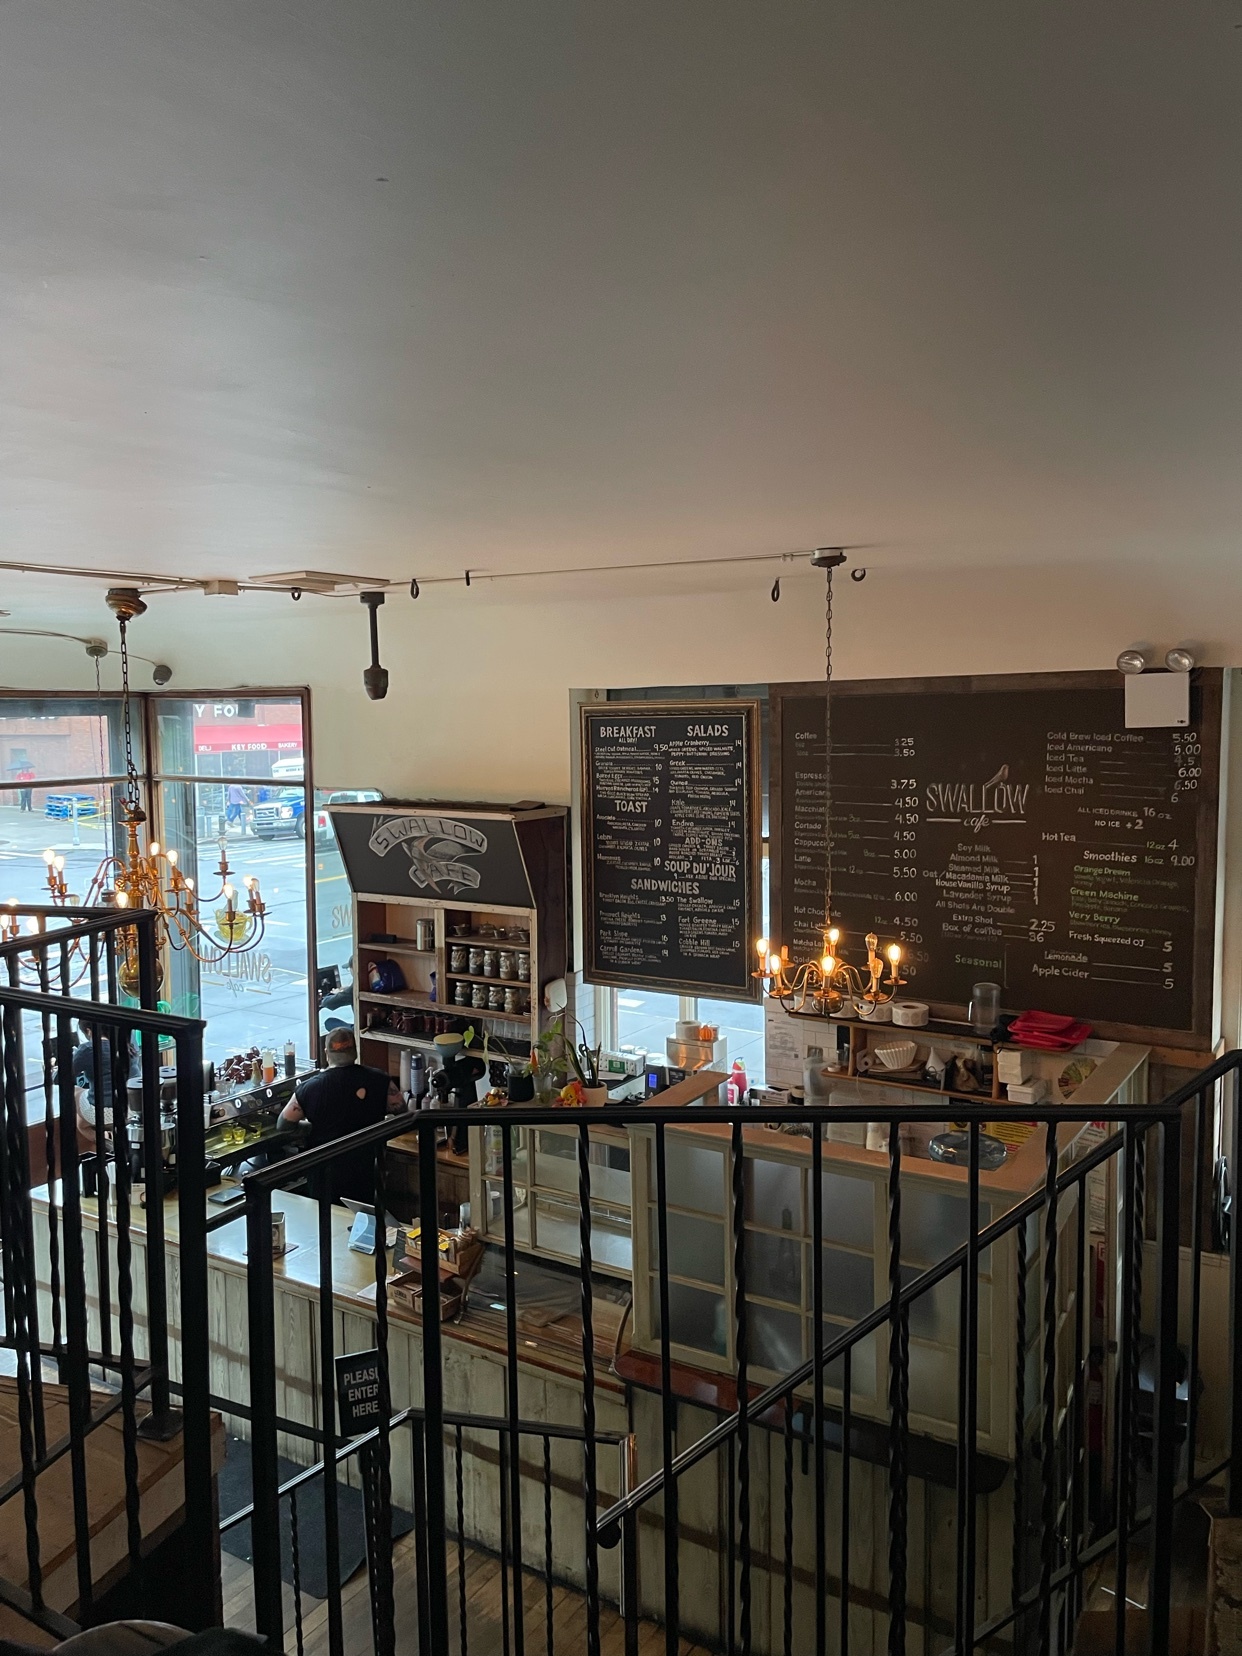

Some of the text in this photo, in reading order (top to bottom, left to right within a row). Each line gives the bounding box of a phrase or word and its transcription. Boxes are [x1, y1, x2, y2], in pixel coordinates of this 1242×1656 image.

[600, 725, 656, 738] BREAKFAST
[687, 724, 729, 737] SALADS
[795, 732, 817, 740] Coffee
[1047, 732, 1144, 742] Cold Brew Iced Coffee
[1172, 732, 1197, 743] 5.50
[894, 748, 915, 756] 3.50
[1047, 743, 1201, 755] Iced Americano 5.00
[1046, 753, 1084, 763] Iced Tea
[1046, 764, 1202, 777] Iced Latte 6.00
[735, 778, 742, 786] 14
[890, 779, 916, 789] 3.75
[1045, 775, 1198, 790] Iced Mocha 6.50
[926, 782, 1029, 814] SWALLOW
[1044, 785, 1179, 803] Iced Chai 6
[614, 800, 647, 813] TOAST
[894, 796, 918, 808] 4.50
[1110, 809, 1138, 817] DRINKS
[1143, 807, 1156, 817] 16
[654, 819, 662, 828] 10
[895, 813, 919, 824] 4.50
[963, 815, 990, 833] cafe
[375, 818, 485, 850] SWALLOW
[894, 831, 916, 841] 4.50
[654, 837, 660, 846] 10
[685, 837, 722, 846] ADD-ONS
[1042, 832, 1058, 841] Hot
[1060, 833, 1076, 842] Tea
[1168, 838, 1180, 851] 4
[894, 849, 916, 859] 5.00
[957, 843, 991, 853] Soy Milk
[654, 857, 660, 866] 10
[794, 854, 811, 862] Latte
[950, 853, 1038, 865] Almond Milk 1
[1083, 850, 1138, 863] Smoothies
[1170, 855, 1195, 867] 9.00
[413, 862, 473, 883] CAFE
[664, 860, 691, 873] SOUP
[693, 862, 736, 878] DU'JOUR
[893, 867, 917, 878] 5.50
[948, 864, 1039, 877] Steamed Milk 1
[1073, 865, 1103, 876] Orange
[794, 878, 817, 886] Mocha
[922, 870, 1039, 887] Oat Macadamia Milk 1
[630, 878, 700, 894] SANDWICHES
[936, 878, 1011, 894] House Vanilla Syrup
[895, 892, 918, 902] 6.00
[943, 889, 1012, 904] Lavender Syrup
[1070, 887, 1097, 897] Green
[1099, 890, 1139, 901] Machine
[733, 899, 740, 907] 15
[948, 901, 970, 910] Shots
[971, 903, 985, 912] Are
[987, 904, 1015, 914] Double
[693, 916, 717, 924] Greene
[731, 918, 740, 926] 15
[894, 916, 918, 927] 4.50
[953, 914, 1056, 932] Extra Shot 2.25
[1069, 911, 1120, 924] Very Berry
[661, 934, 668, 942] 16
[900, 932, 922, 943] 5.50
[942, 923, 959, 931] Box
[962, 924, 972, 932] of
[975, 927, 1002, 936] coffee
[1029, 931, 1044, 942] 36
[679, 938, 698, 946] Cobble
[700, 939, 710, 947] Hill
[1069, 931, 1173, 952] Fresh Squeezed OJ 5
[955, 954, 1002, 968] Seasonal
[1044, 951, 1173, 973] Lemonade 5
[1032, 964, 1174, 989] Apple Cider 5
[348, 1382, 378, 1402] ENTER
[352, 1400, 380, 1418] HERE
